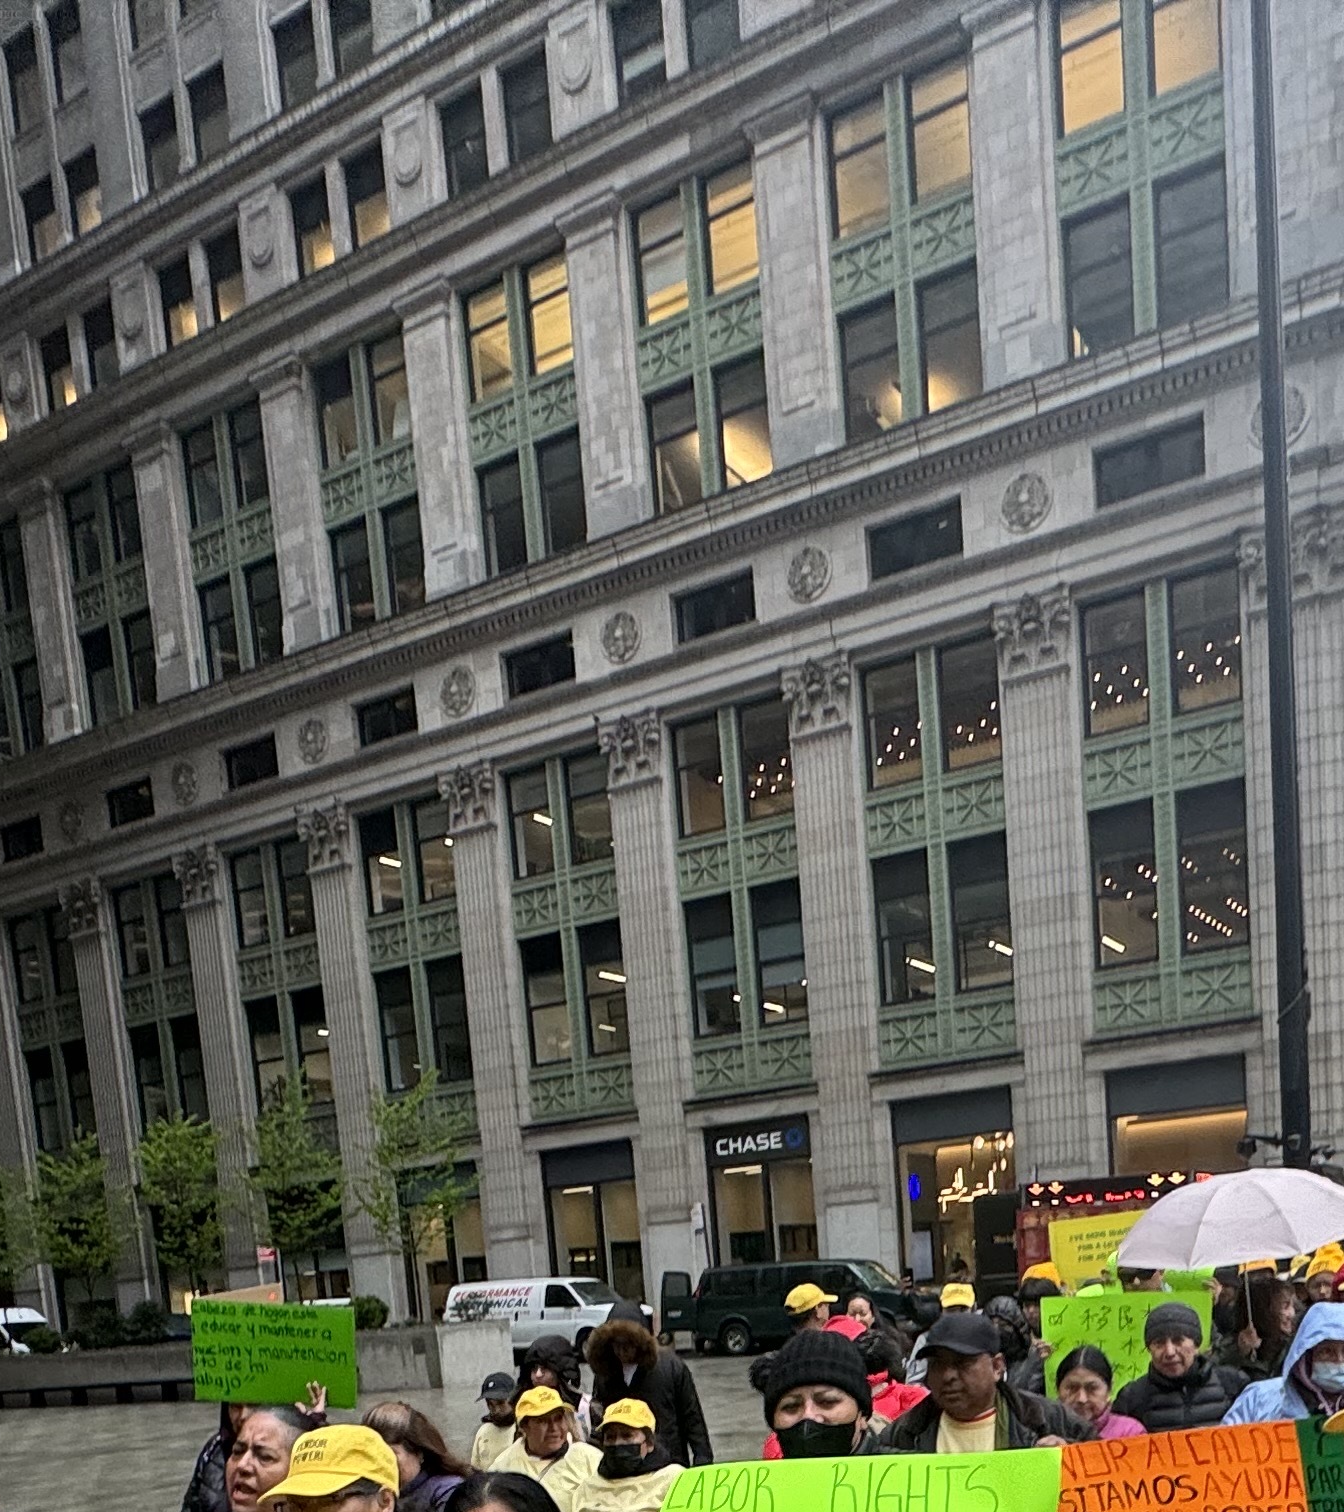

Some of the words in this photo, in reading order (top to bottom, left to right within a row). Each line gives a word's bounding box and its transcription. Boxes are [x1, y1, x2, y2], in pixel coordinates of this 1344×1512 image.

[716, 1131, 783, 1156] CHASE
[450, 1296, 530, 1310] NICAL
[1146, 1422, 1299, 1470] ALCALDE
[1203, 1466, 1305, 1501] AYUDA
